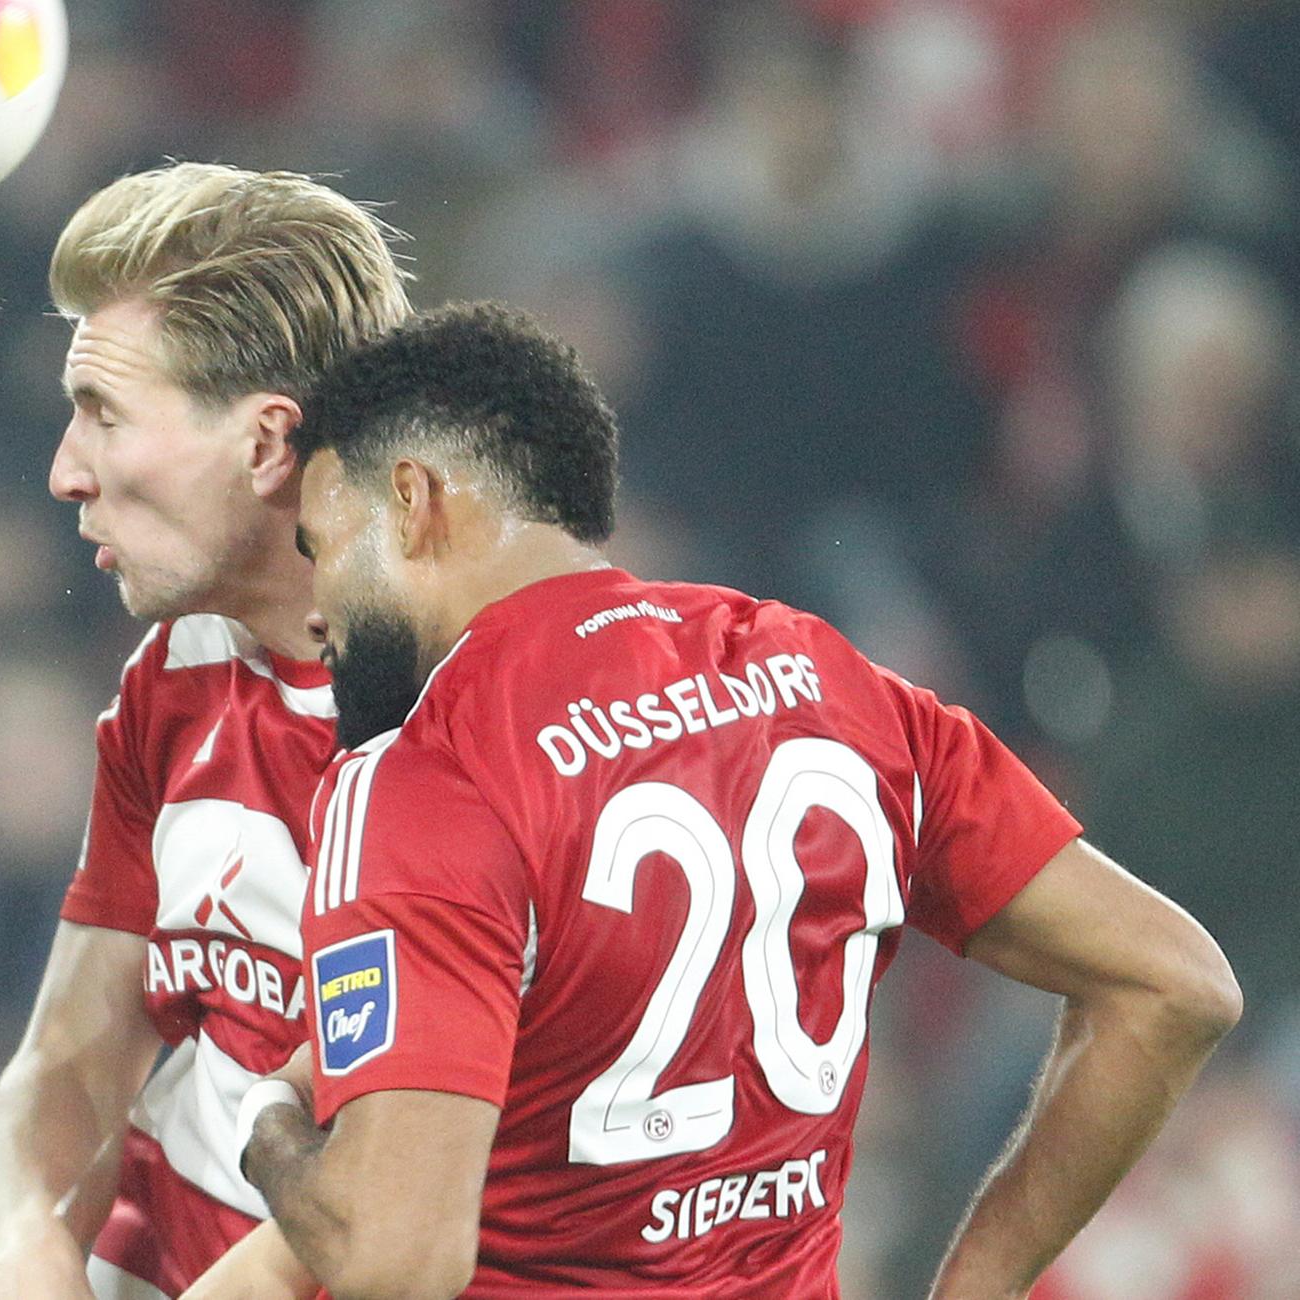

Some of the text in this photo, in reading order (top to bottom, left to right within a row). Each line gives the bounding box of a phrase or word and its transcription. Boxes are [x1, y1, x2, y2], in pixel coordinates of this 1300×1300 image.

[536, 653, 822, 777] DÜSSELDORF
[321, 966, 382, 1002] METRO
[568, 737, 905, 1165] 20
[327, 1001, 376, 1043] Chef
[640, 1149, 827, 1244] SIEBERT
